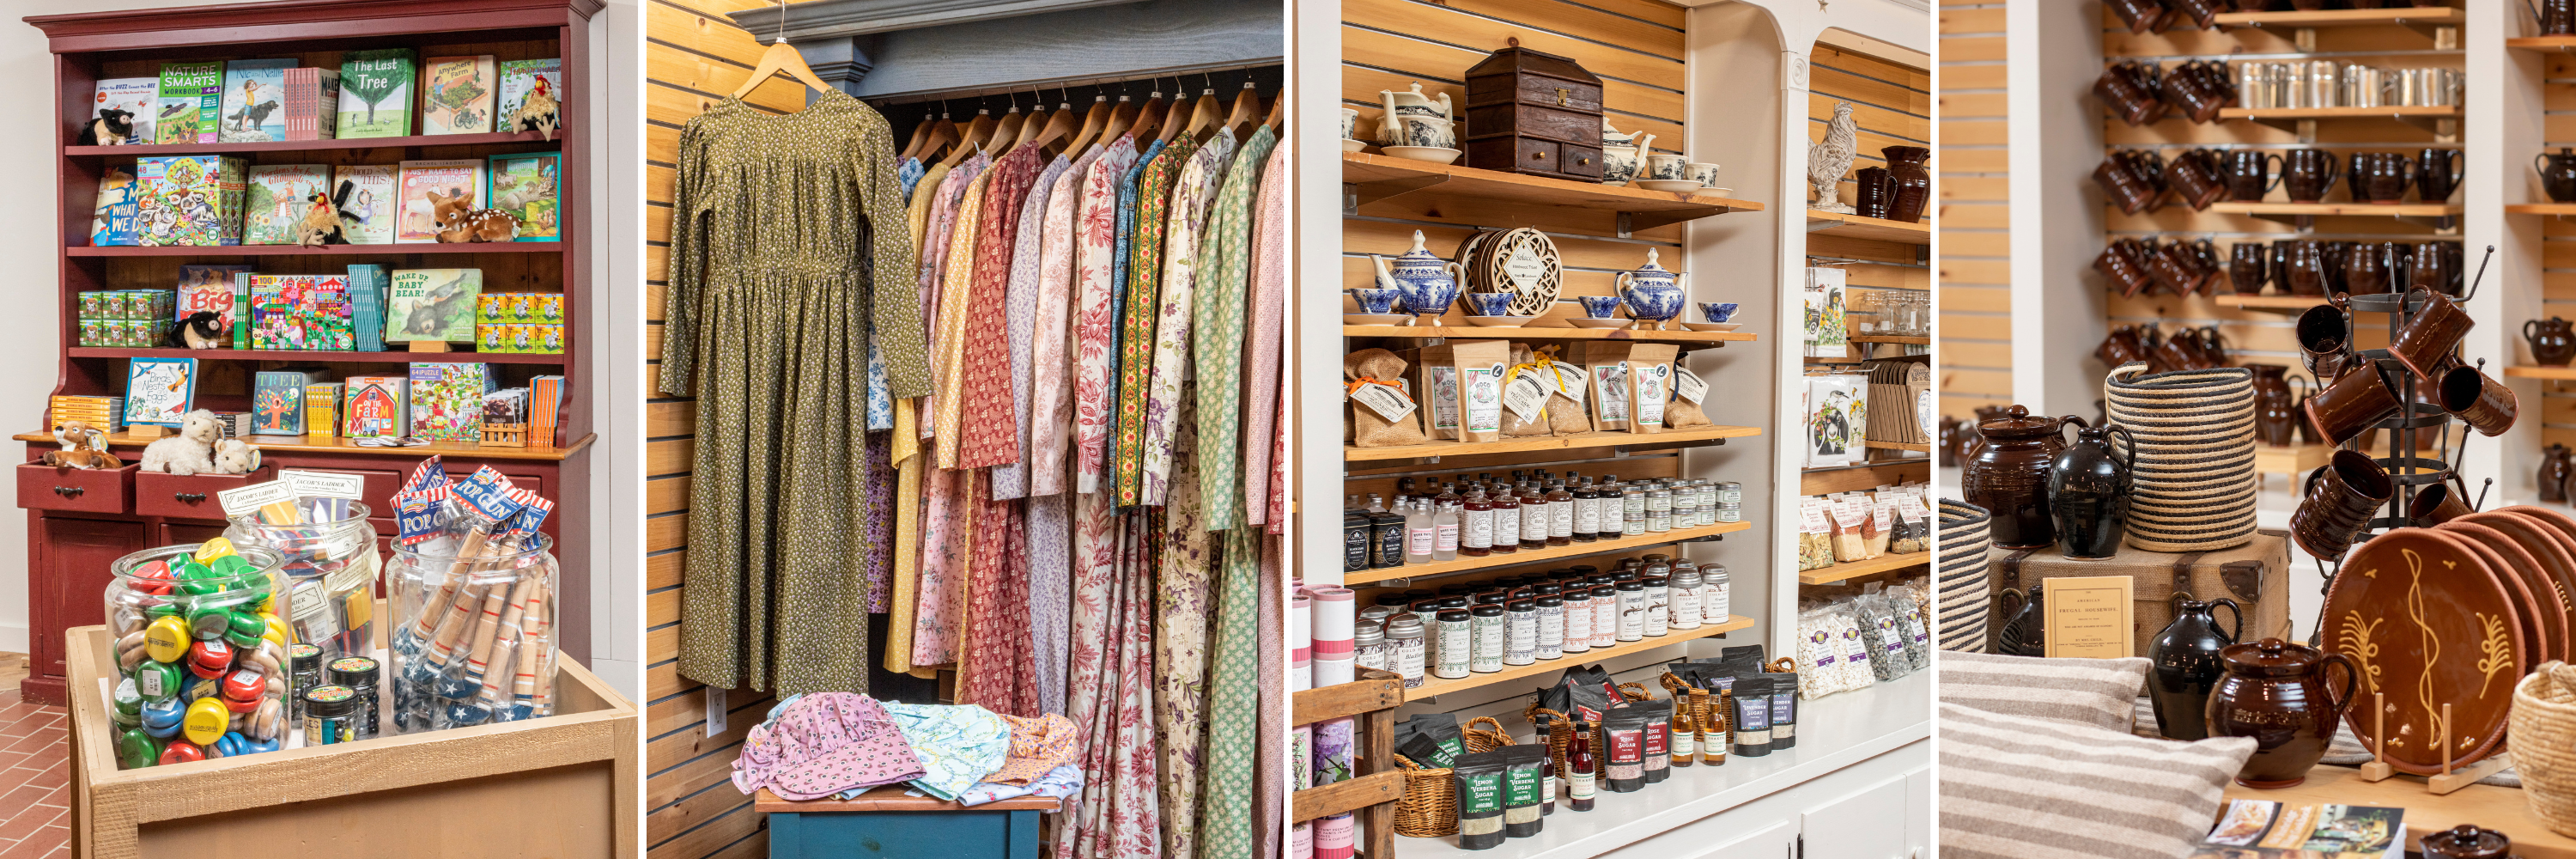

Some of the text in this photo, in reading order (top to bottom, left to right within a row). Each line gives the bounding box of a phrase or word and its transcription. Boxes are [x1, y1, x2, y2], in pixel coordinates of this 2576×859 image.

[165, 65, 216, 76] NATURE
[354, 58, 397, 71] The Last
[438, 60, 471, 76] Anywhere
[236, 68, 251, 79] Nic
[261, 67, 284, 78] Nellie
[450, 69, 469, 79] Farm
[164, 76, 216, 87] SMARTS
[358, 74, 388, 90] Tree
[138, 166, 147, 174] 48
[261, 165, 316, 179] Gardens Are for
[269, 174, 304, 185] GROWING
[361, 175, 391, 185] THIS!
[418, 174, 468, 183] GOOD NIGHT
[113, 204, 135, 216] WHAT
[112, 217, 128, 232] WE
[394, 273, 416, 282] WAKE
[190, 289, 234, 313] Big
[142, 380, 166, 391] Nests
[258, 375, 300, 386] TREE
[146, 391, 168, 404] Eggs
[237, 488, 279, 502] JACOB'S LADDER
[457, 480, 511, 519] POP GUN
[403, 514, 430, 534] POP
